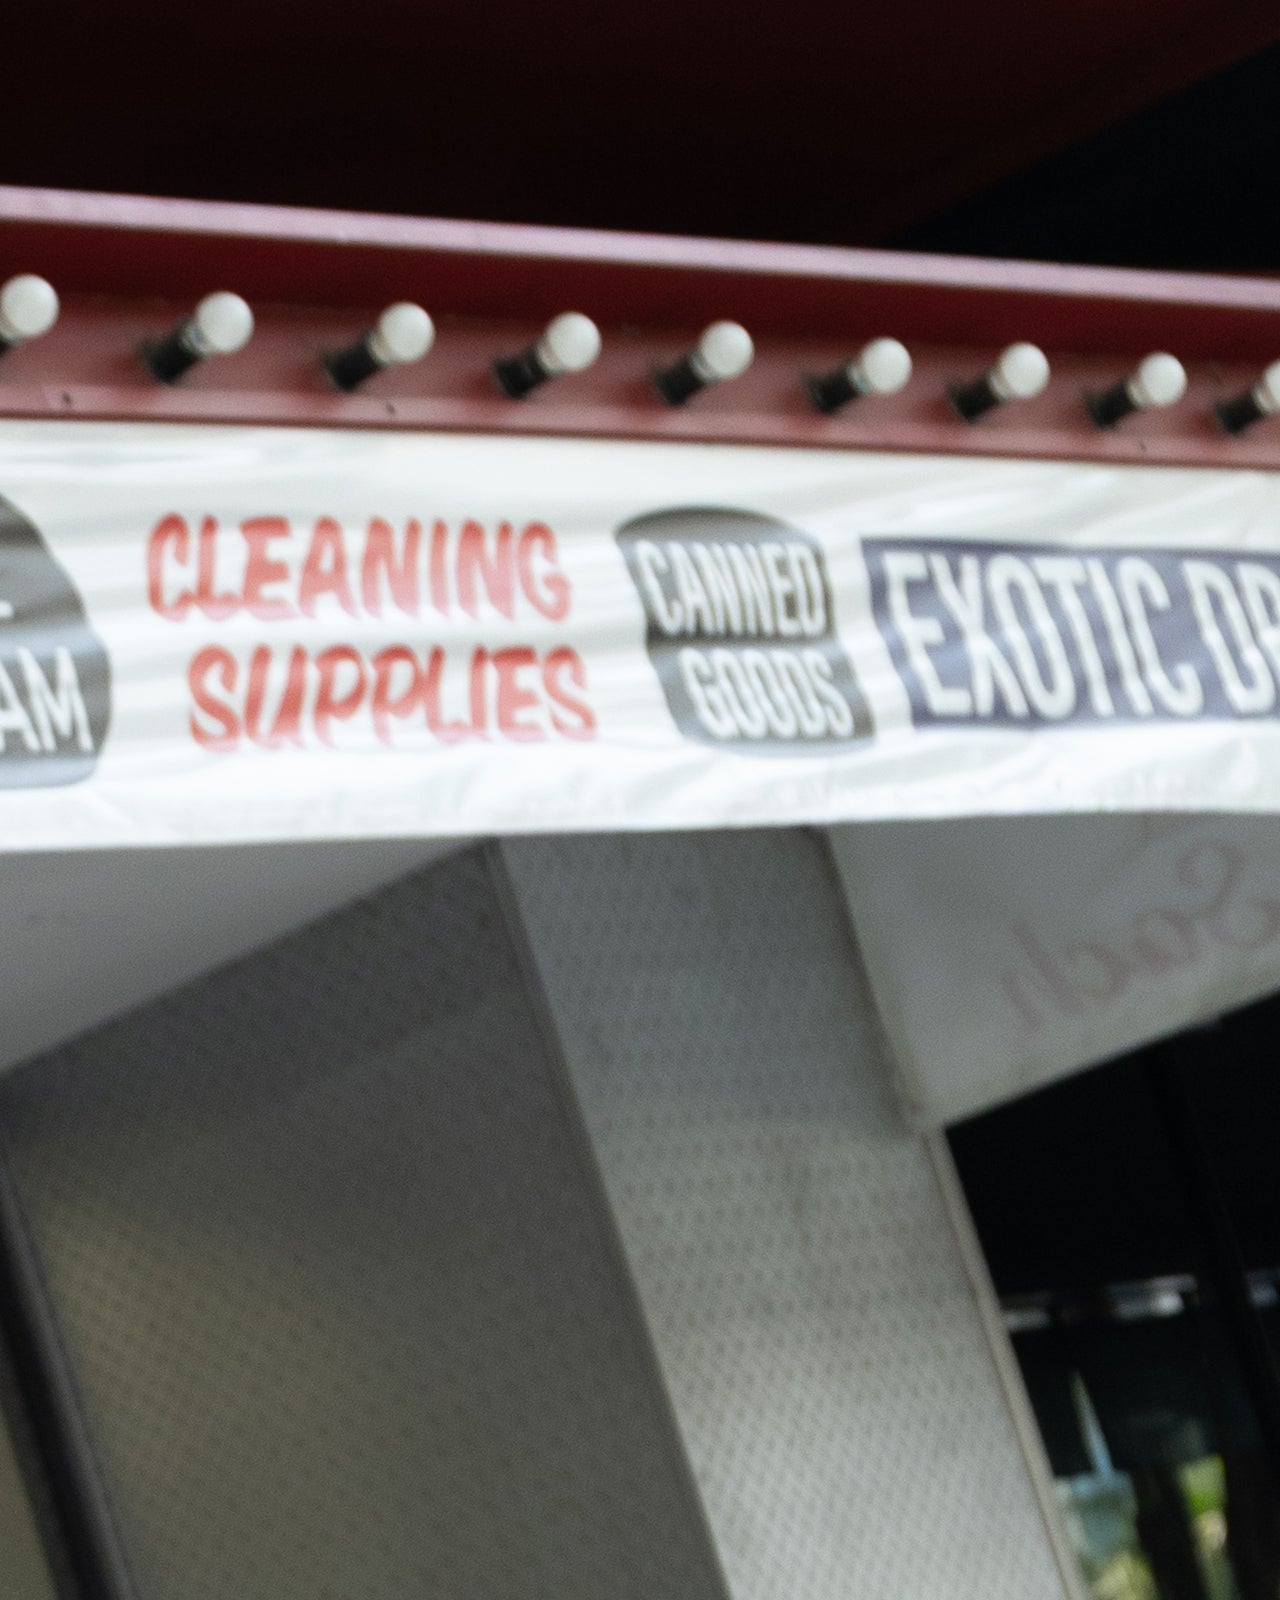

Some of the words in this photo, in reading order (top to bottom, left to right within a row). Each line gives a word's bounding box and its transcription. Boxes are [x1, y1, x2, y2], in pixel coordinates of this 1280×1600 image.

[146, 513, 572, 622] CLEANING
[636, 539, 828, 639] CANNED
[882, 551, 1203, 720] EXOTIC
[187, 643, 599, 752] SUPPLIES
[679, 647, 855, 740] GOODS
